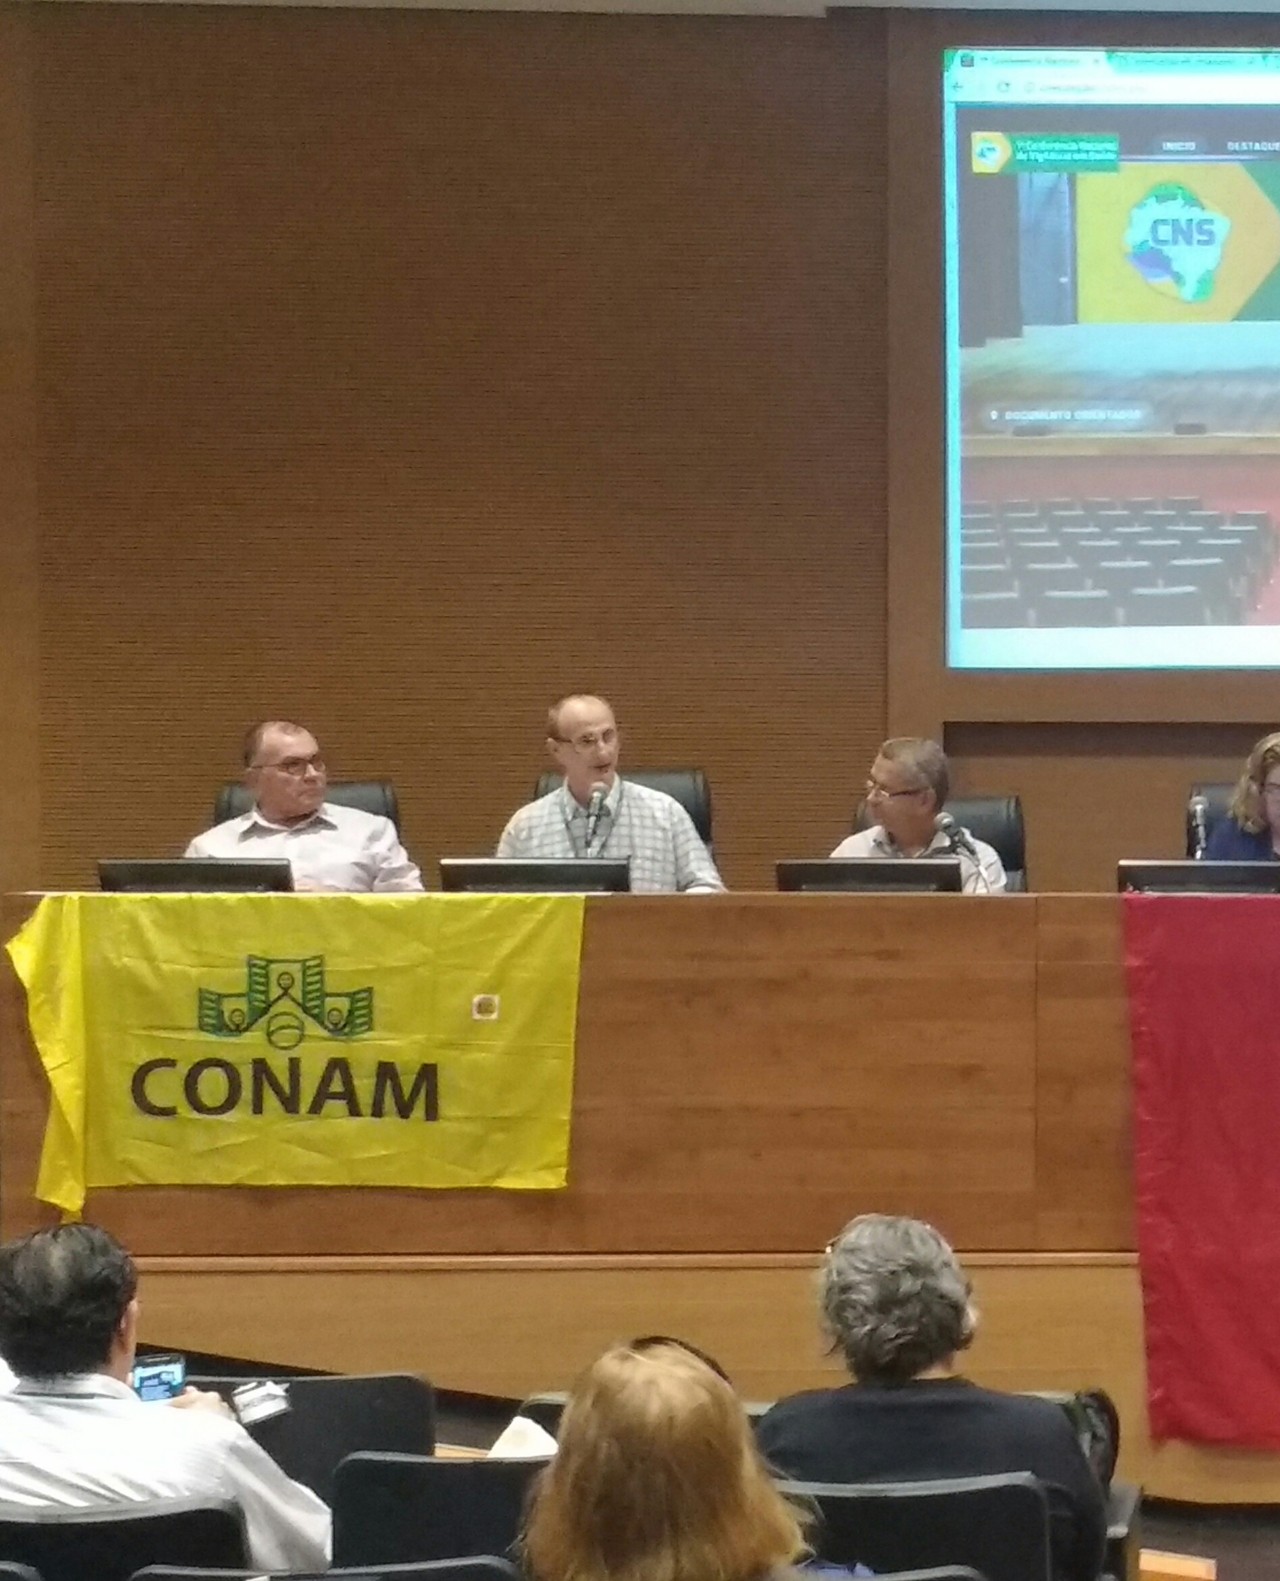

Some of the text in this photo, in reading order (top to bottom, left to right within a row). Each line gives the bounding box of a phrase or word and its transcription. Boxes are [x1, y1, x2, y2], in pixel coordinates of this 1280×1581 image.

[1227, 141, 1280, 151] DESTAQUE
[1151, 218, 1216, 246] CNS
[130, 1056, 439, 1122] CONAM
